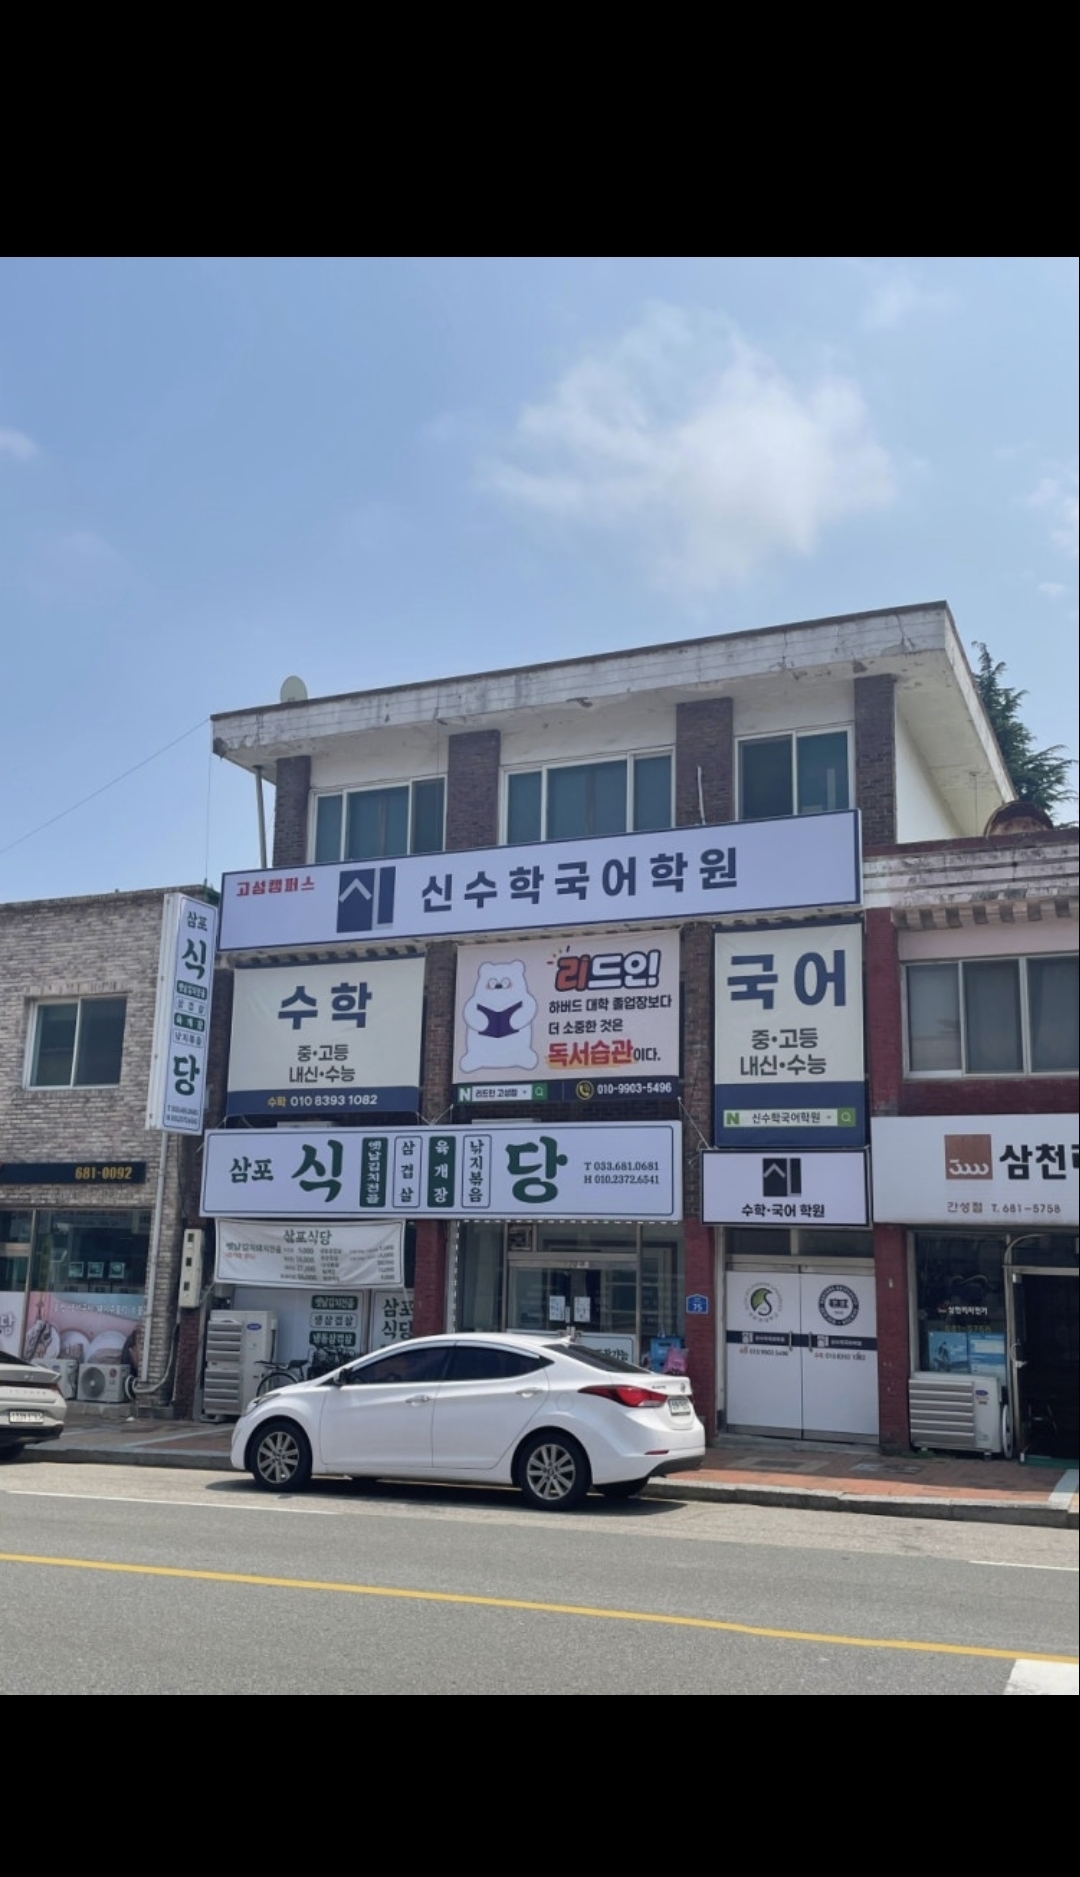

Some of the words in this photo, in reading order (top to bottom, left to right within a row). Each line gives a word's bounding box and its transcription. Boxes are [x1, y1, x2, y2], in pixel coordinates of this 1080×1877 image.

[421, 847, 737, 913] 신수학국어학원
[186, 911, 208, 931] 삼포
[181, 938, 207, 980] 식
[555, 949, 662, 992] 리드인!
[727, 950, 846, 1010] 국어
[278, 982, 372, 1030] 수학
[549, 1000, 583, 1014] 하버드
[586, 998, 610, 1011] 대학
[613, 994, 672, 1010] 졸업장보다
[549, 1022, 559, 1035] 더
[563, 1020, 597, 1034] 소중한
[600, 1018, 623, 1033] 것은
[173, 1054, 200, 1096] 당
[597, 1082, 673, 1095] 010-9903-5496
[267, 1096, 286, 1108] 수학
[290, 1096, 312, 1107] 010
[314, 1095, 345, 1106] 8393
[348, 1094, 378, 1105] 1082
[752, 1111, 821, 1124] 신수학국어학원
[230, 1156, 274, 1183] 삼포
[291, 1139, 343, 1202] 식
[506, 1136, 568, 1204] 당
[401, 1140, 416, 1203] 삼겹살
[433, 1140, 449, 1203] 육개장
[584, 1162, 592, 1171] T
[999, 1143, 1079, 1180] 삼천
[75, 1166, 133, 1180] 681-0092
[584, 1174, 592, 1184] H
[594, 1174, 659, 1184] 010.2372.6541
[800, 1203, 825, 1218] 학원
[284, 1229, 332, 1245] 삼포식당
